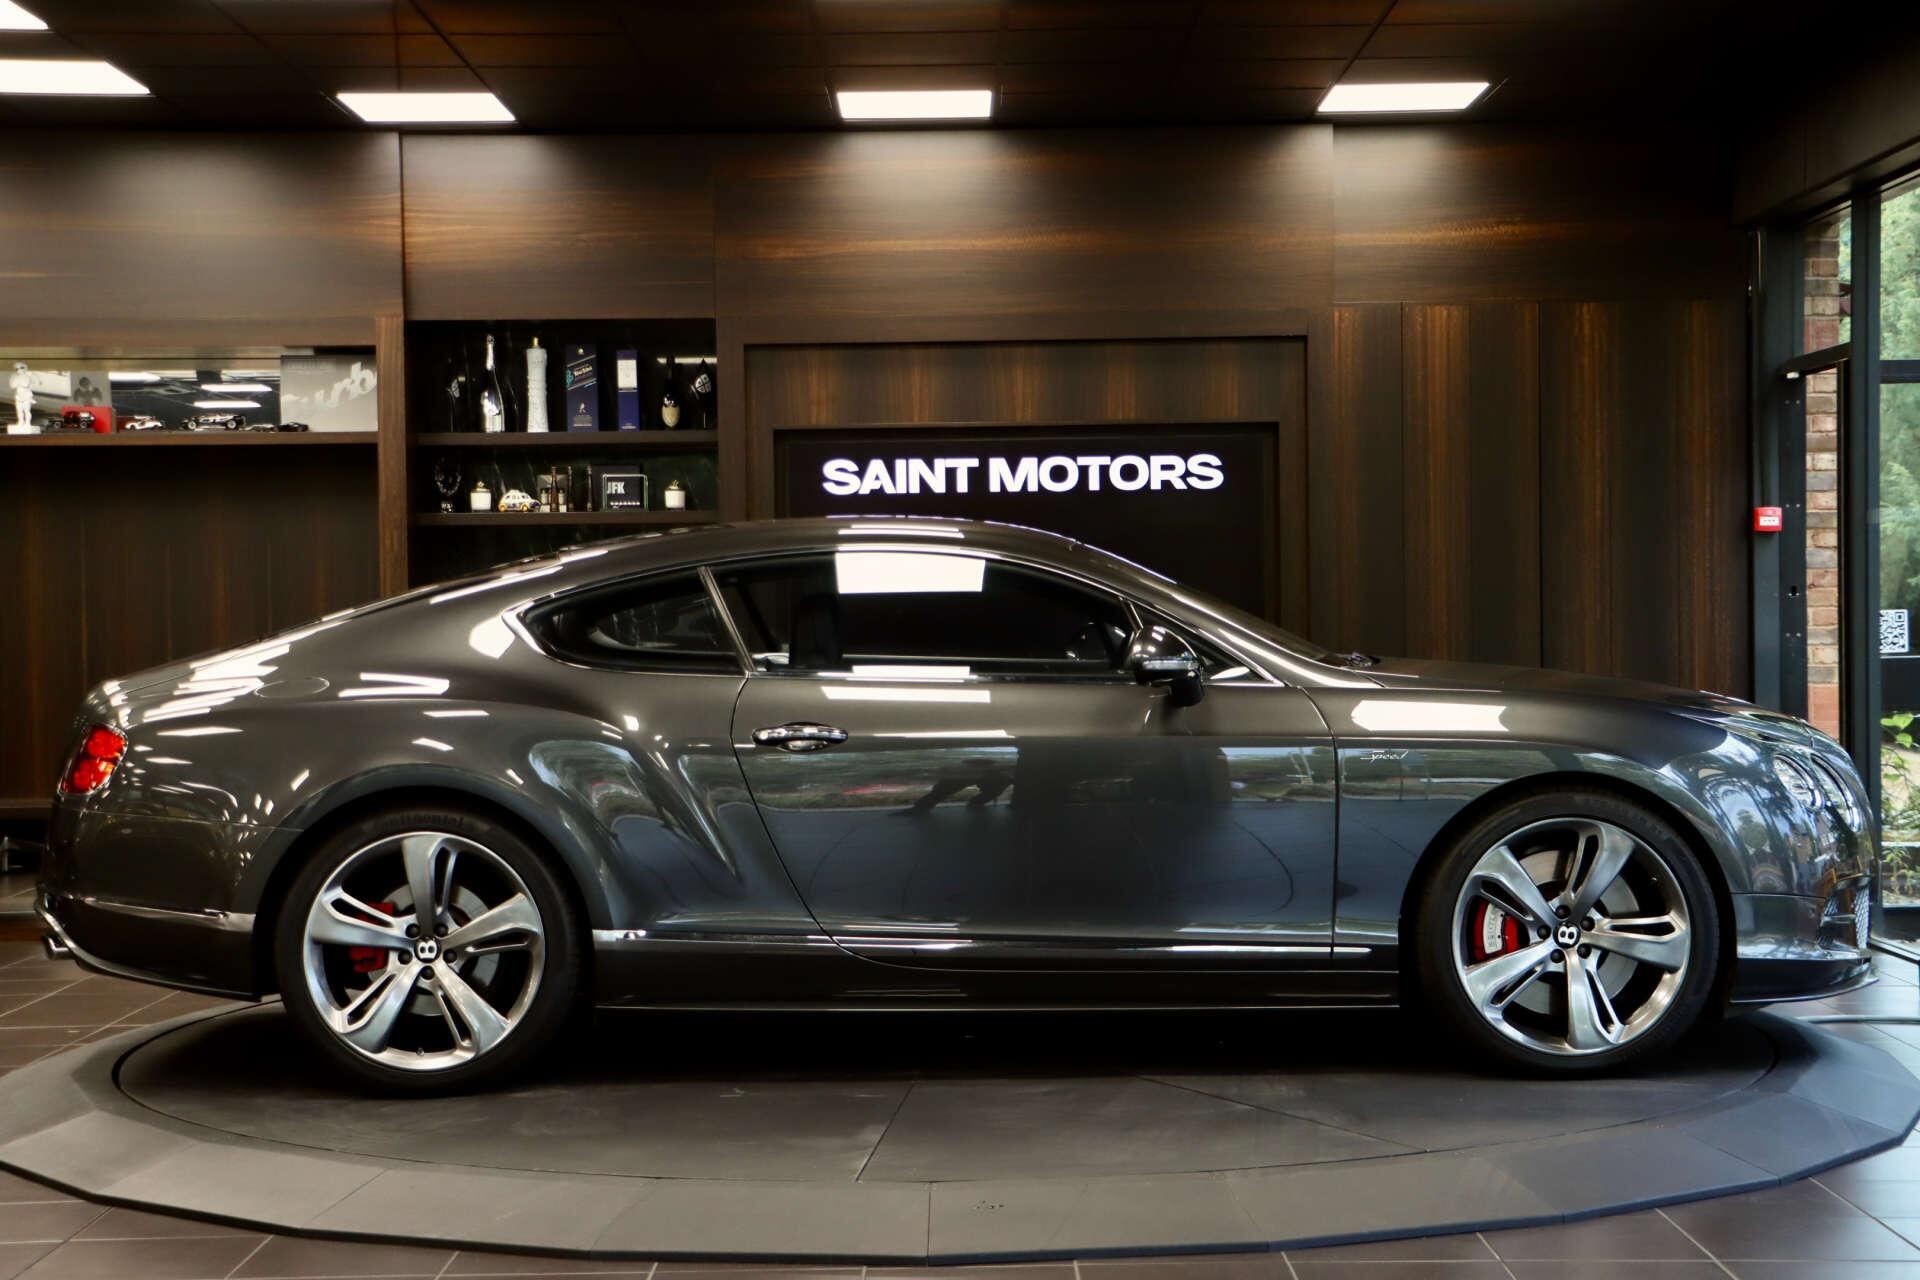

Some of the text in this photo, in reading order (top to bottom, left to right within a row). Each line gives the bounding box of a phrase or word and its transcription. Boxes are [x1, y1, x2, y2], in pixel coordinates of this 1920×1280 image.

[606, 481, 625, 494] JFK
[822, 453, 1225, 496] SAINT MOTORS
